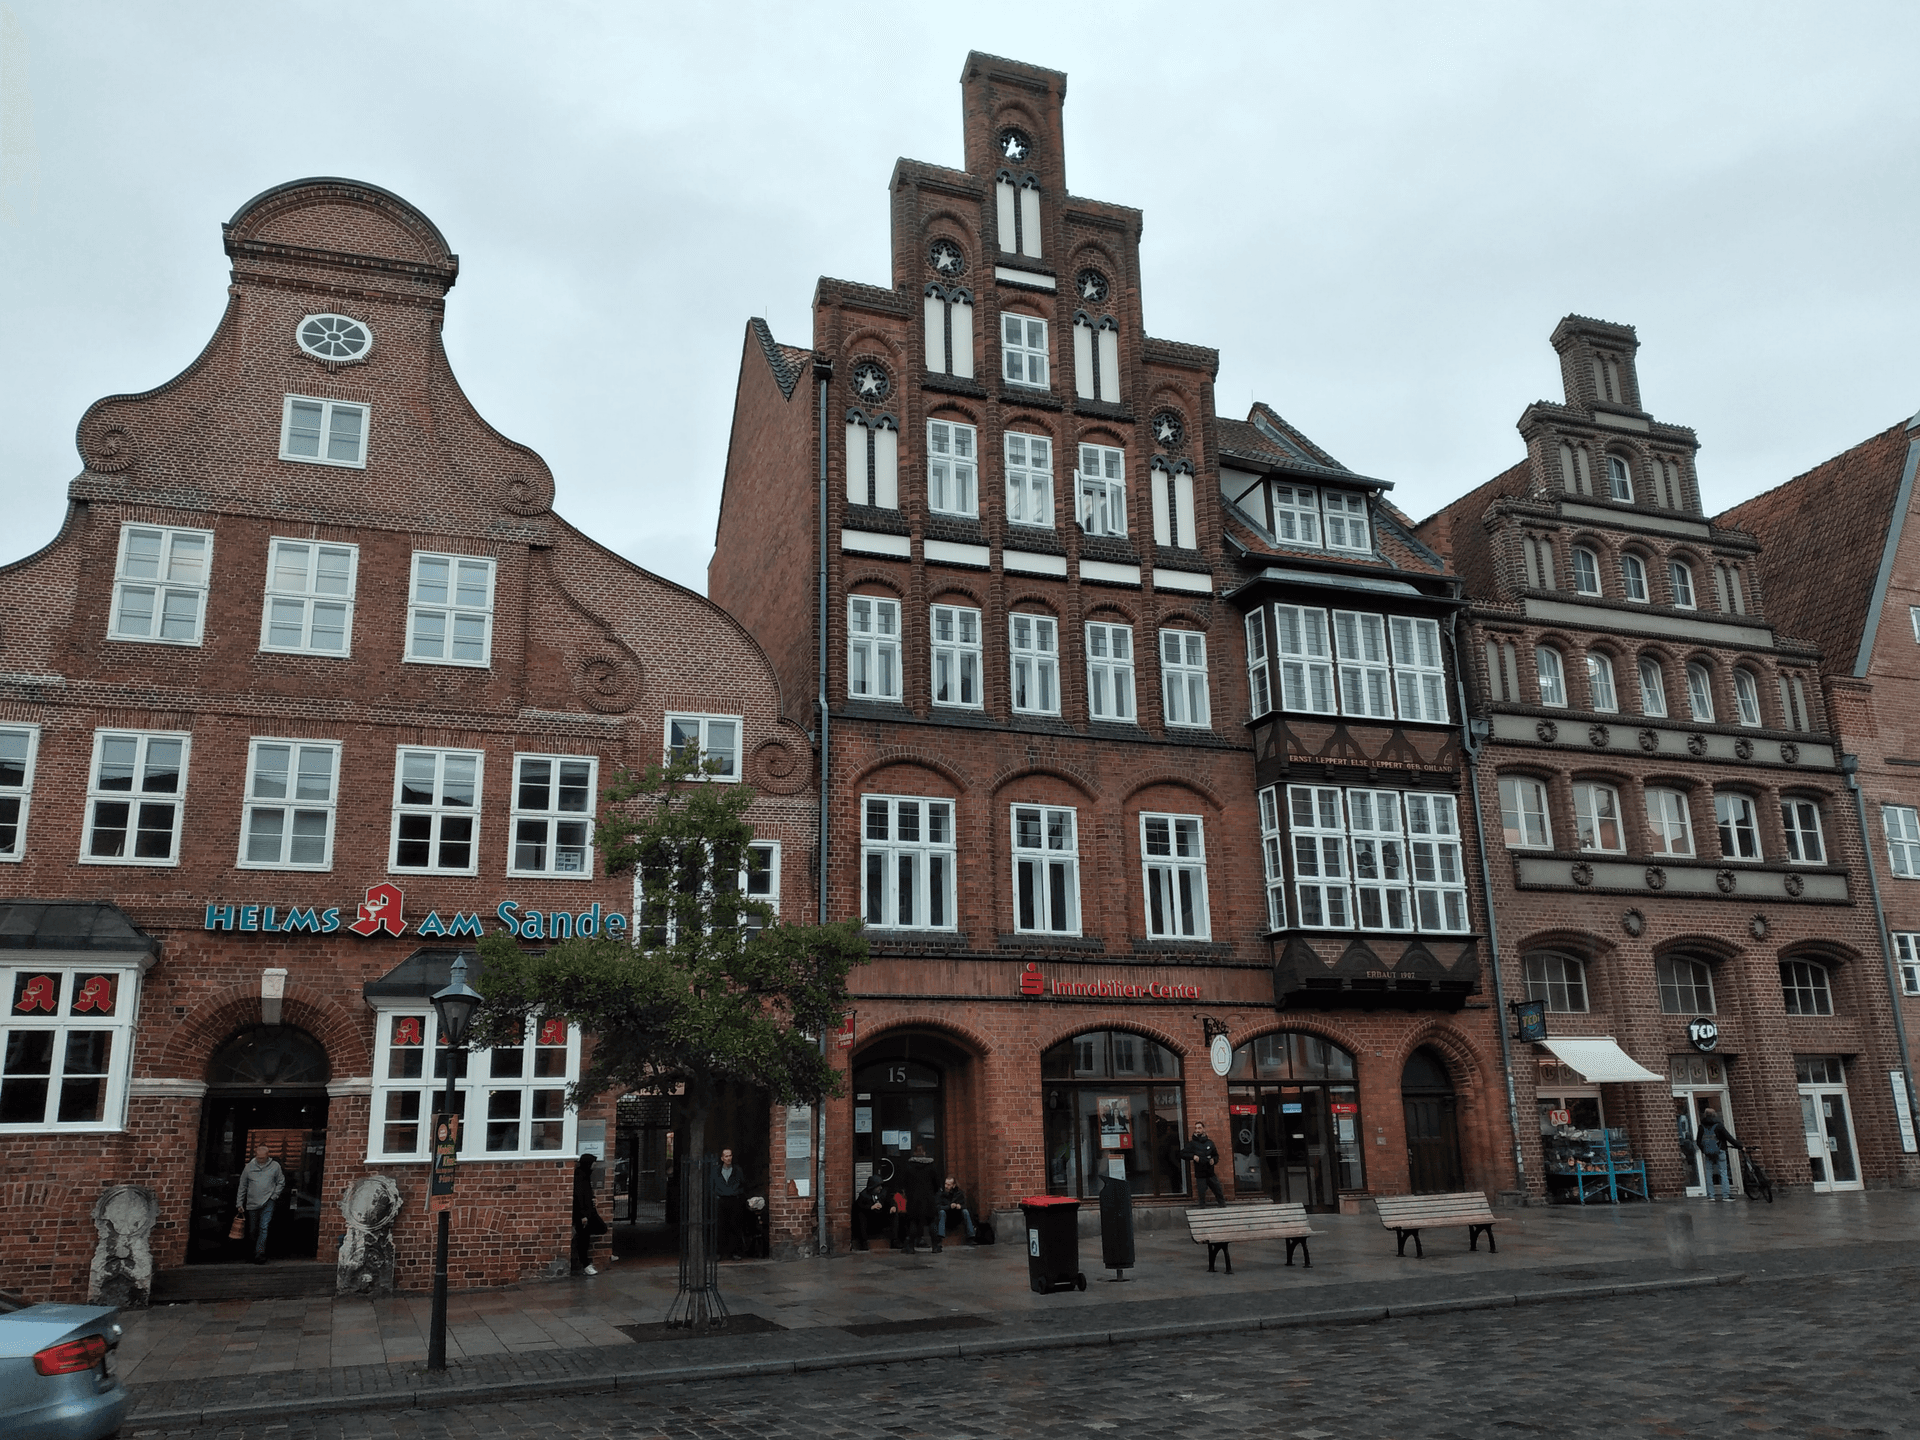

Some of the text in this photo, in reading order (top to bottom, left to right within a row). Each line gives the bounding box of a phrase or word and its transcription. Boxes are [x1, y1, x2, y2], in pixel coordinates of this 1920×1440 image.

[1289, 754, 1313, 763] ERNST
[1315, 756, 1348, 766] LEPPERT
[1350, 759, 1369, 767] ELSE
[1371, 760, 1404, 769] LEPPERT
[1423, 764, 1453, 773] OHLAND
[204, 904, 341, 934] HELMS
[497, 900, 627, 941] Sande
[1366, 970, 1397, 979] ERBAUT
[1051, 979, 1202, 999] Immobilien-Center
[888, 1066, 906, 1083] 15
